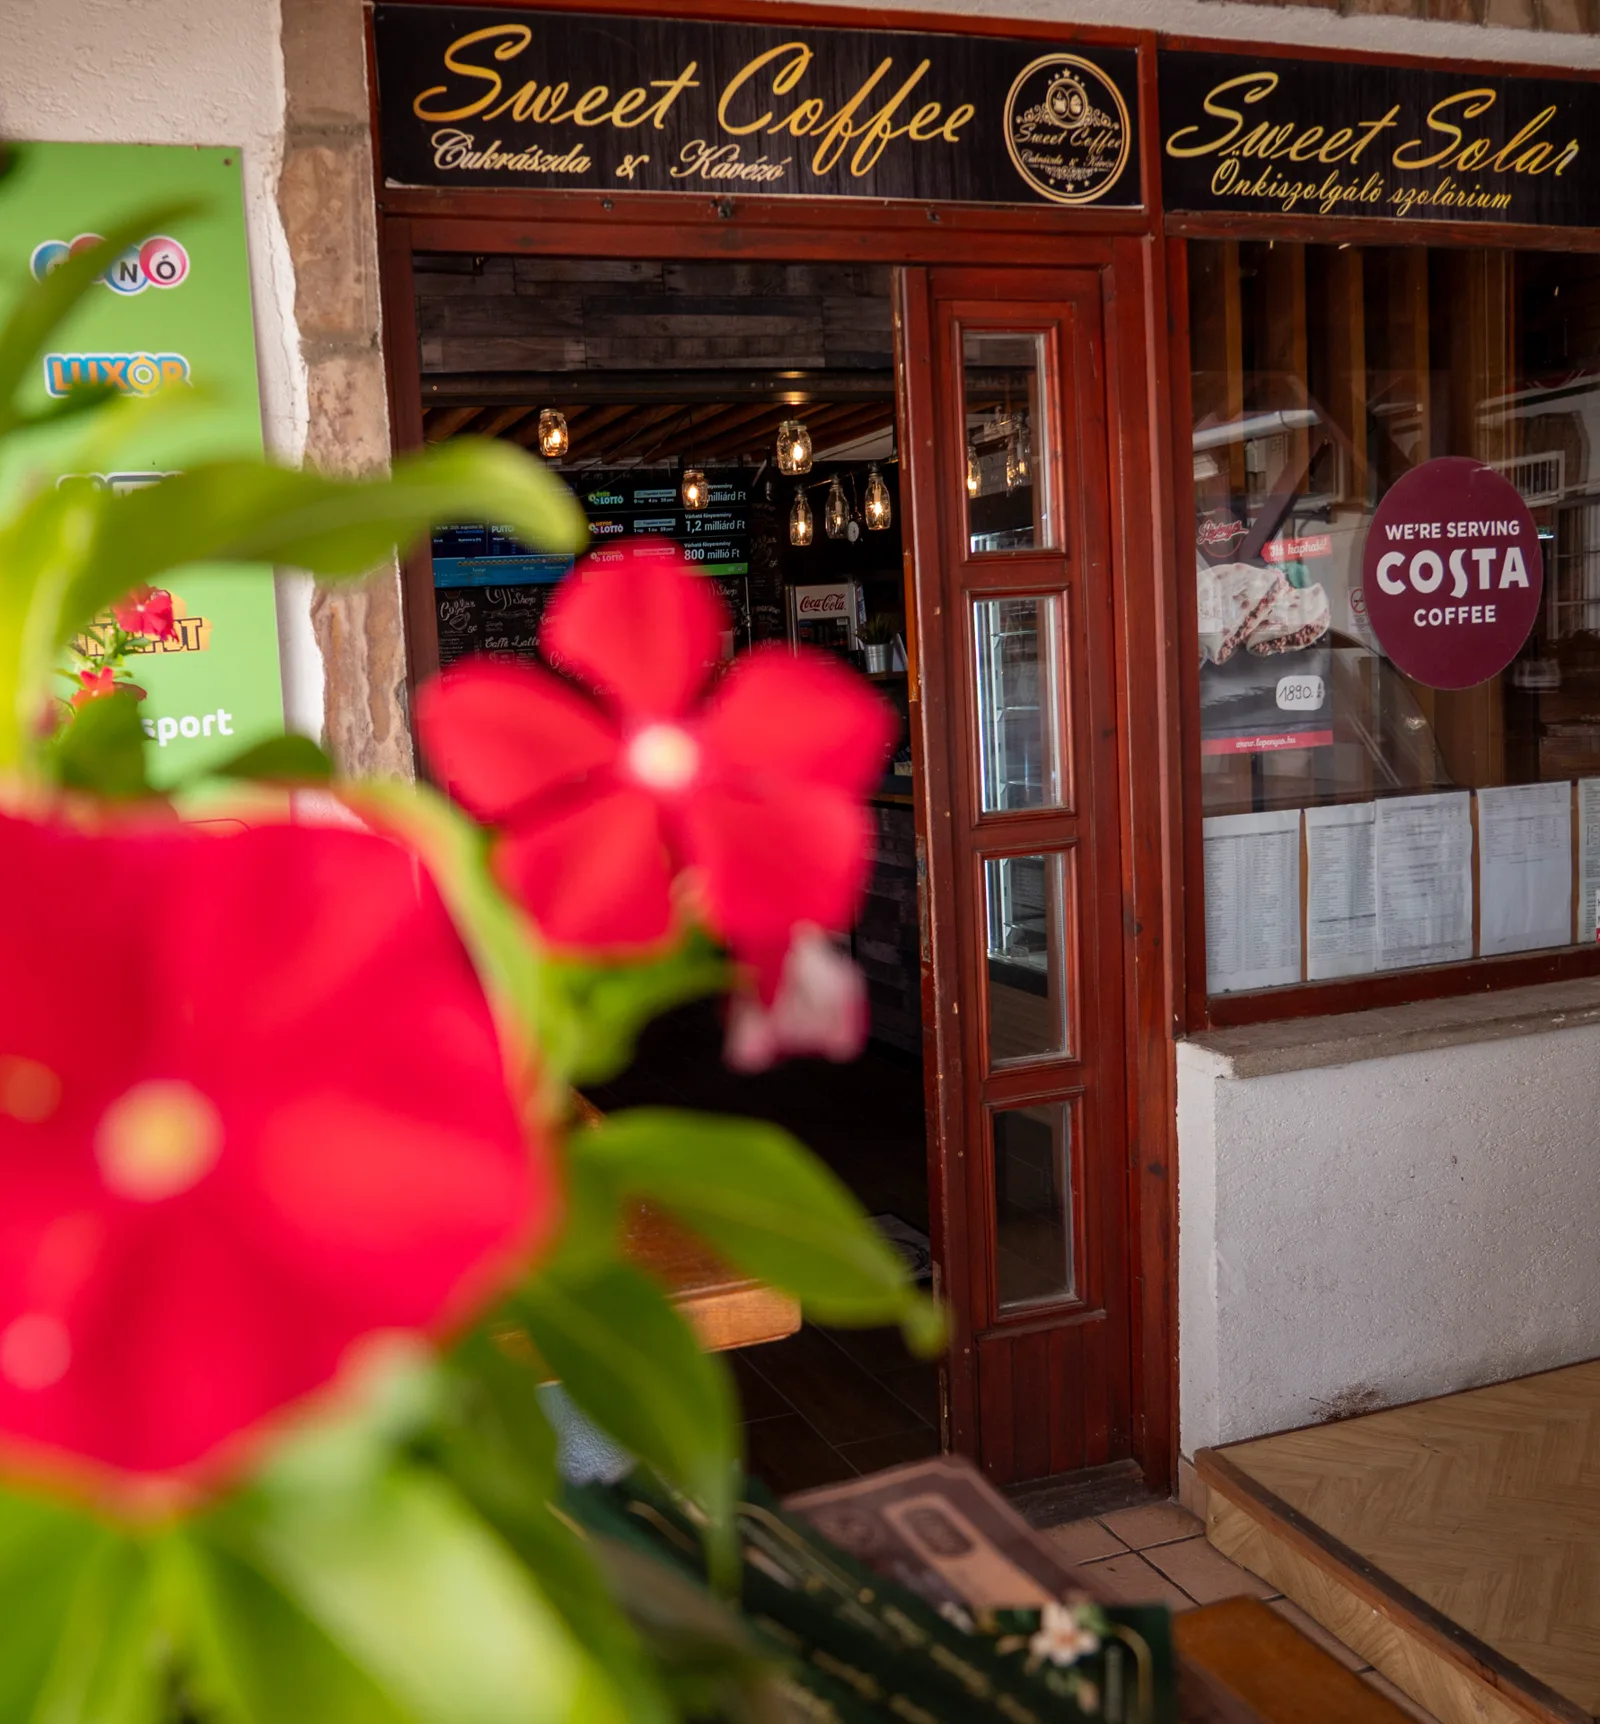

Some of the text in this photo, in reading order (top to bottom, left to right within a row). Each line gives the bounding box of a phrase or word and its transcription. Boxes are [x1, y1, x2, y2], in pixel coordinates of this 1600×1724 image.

[413, 24, 975, 177] Sweet Coffee
[1166, 71, 1580, 176] Sweet Solar
[1014, 122, 1122, 155] Sweet Coffee
[431, 128, 792, 183] Cukrászda & Kávézó
[1210, 149, 1512, 217] Önkiszolgáló szolárium
[600, 495, 624, 505] LOTTÓ
[738, 490, 747, 501] Ft
[600, 524, 624, 534] LOTTÓ
[685, 520, 702, 534] 1,2
[704, 520, 736, 531] milliárd
[737, 519, 746, 530] Ft
[1446, 520, 1520, 538] SERVING
[684, 549, 705, 560] 800
[707, 549, 730, 559] millió
[731, 549, 740, 558] Ft
[1376, 546, 1530, 599] COSTA
[800, 593, 847, 613] Coca-Cola
[1413, 605, 1497, 627] COFFEE
